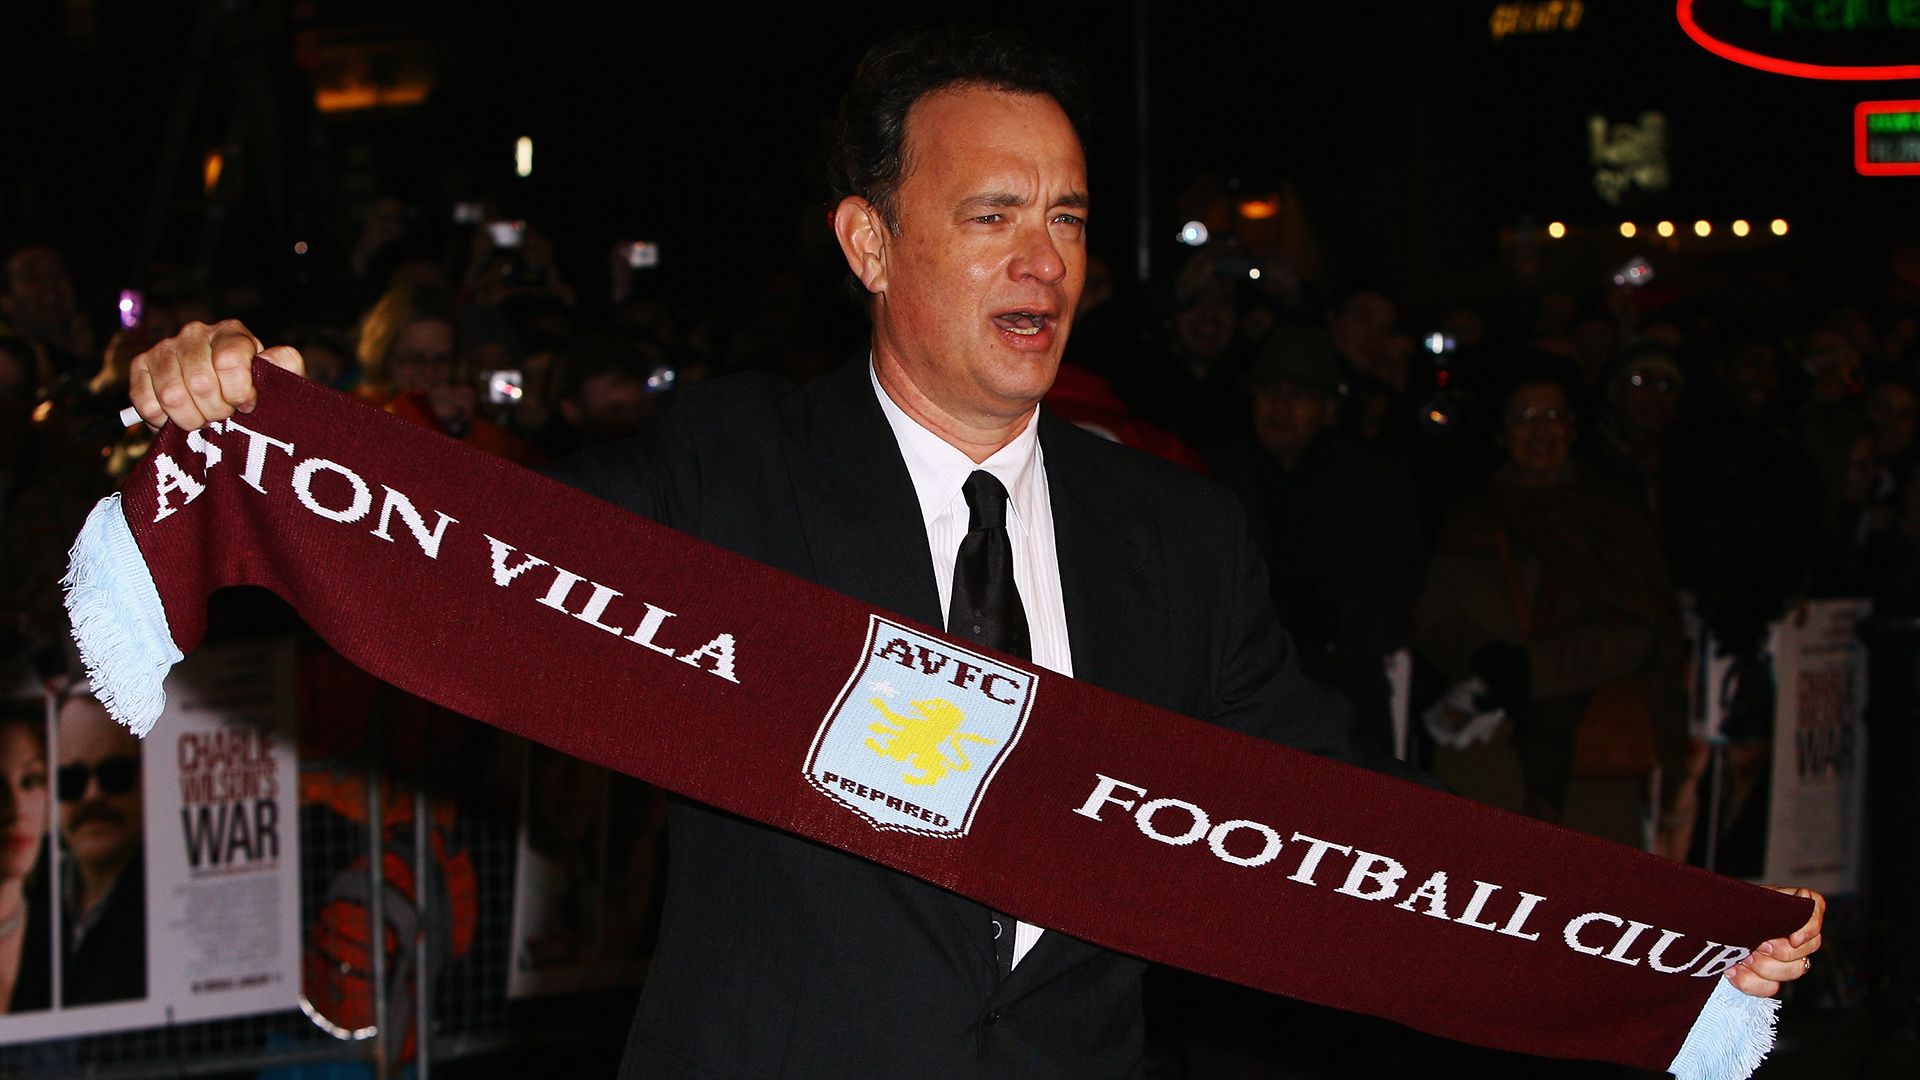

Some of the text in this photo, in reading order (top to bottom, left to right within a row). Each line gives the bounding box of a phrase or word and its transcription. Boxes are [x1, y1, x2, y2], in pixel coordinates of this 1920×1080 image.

[153, 417, 741, 684] ASTON VILLA
[873, 638, 1021, 705] AVFC
[180, 799, 280, 868] WAR
[821, 771, 951, 828] PREPARED
[1072, 773, 1750, 977] FOOTBALL CLUB
